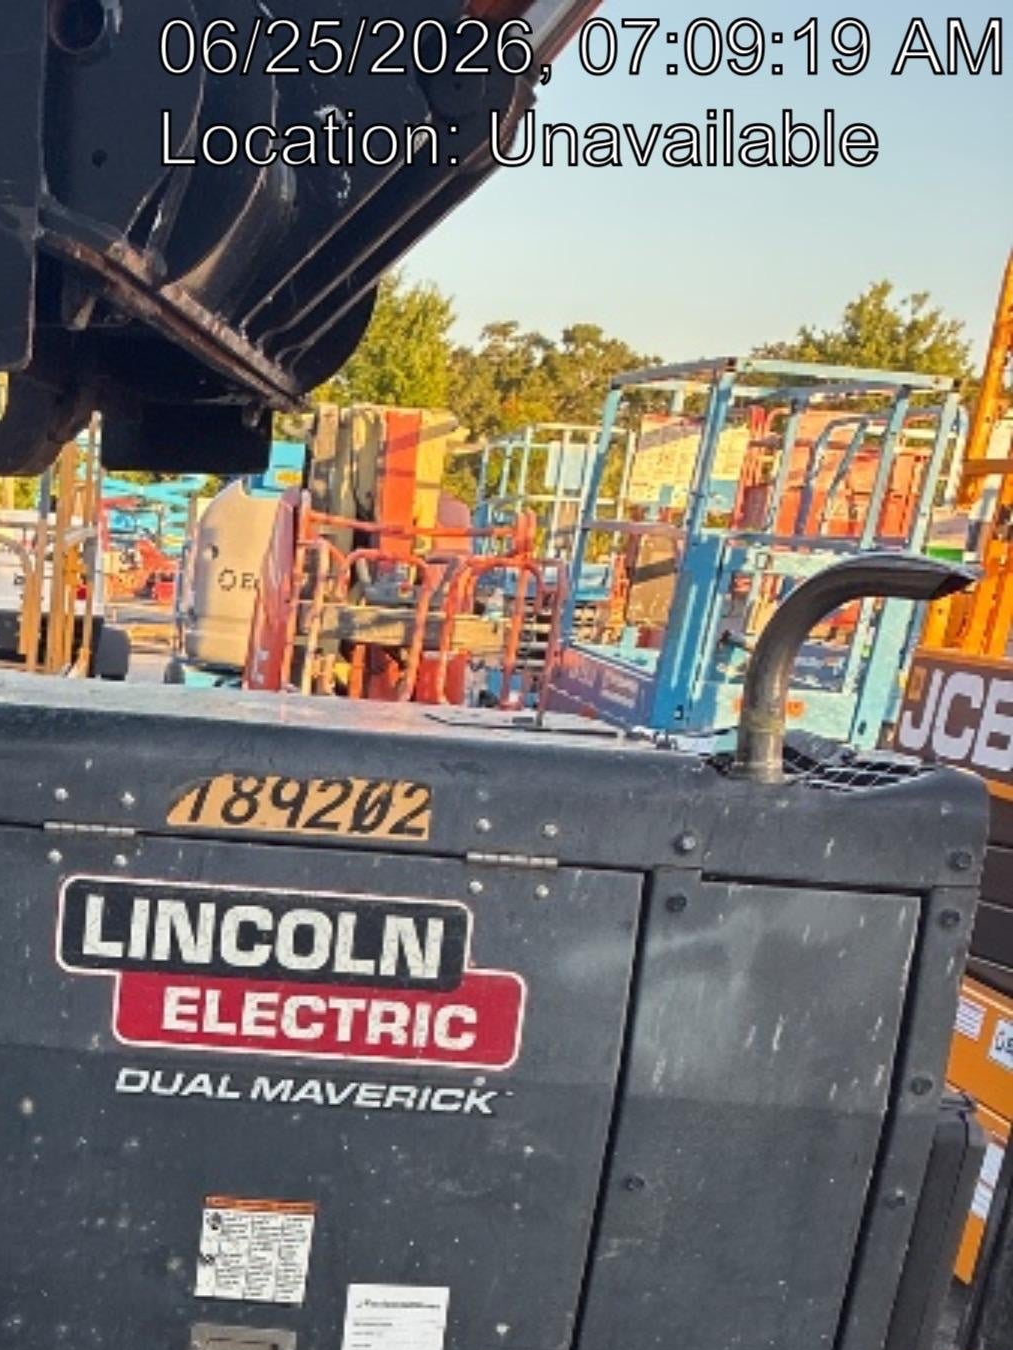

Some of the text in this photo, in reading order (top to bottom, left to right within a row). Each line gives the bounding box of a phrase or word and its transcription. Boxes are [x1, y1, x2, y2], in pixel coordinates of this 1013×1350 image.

[898, 668, 1013, 772] JCB
[82, 893, 445, 980] LINCOLN
[161, 986, 479, 1051] ELECTRIC
[115, 1067, 498, 1116] DUAL MAVERICK
